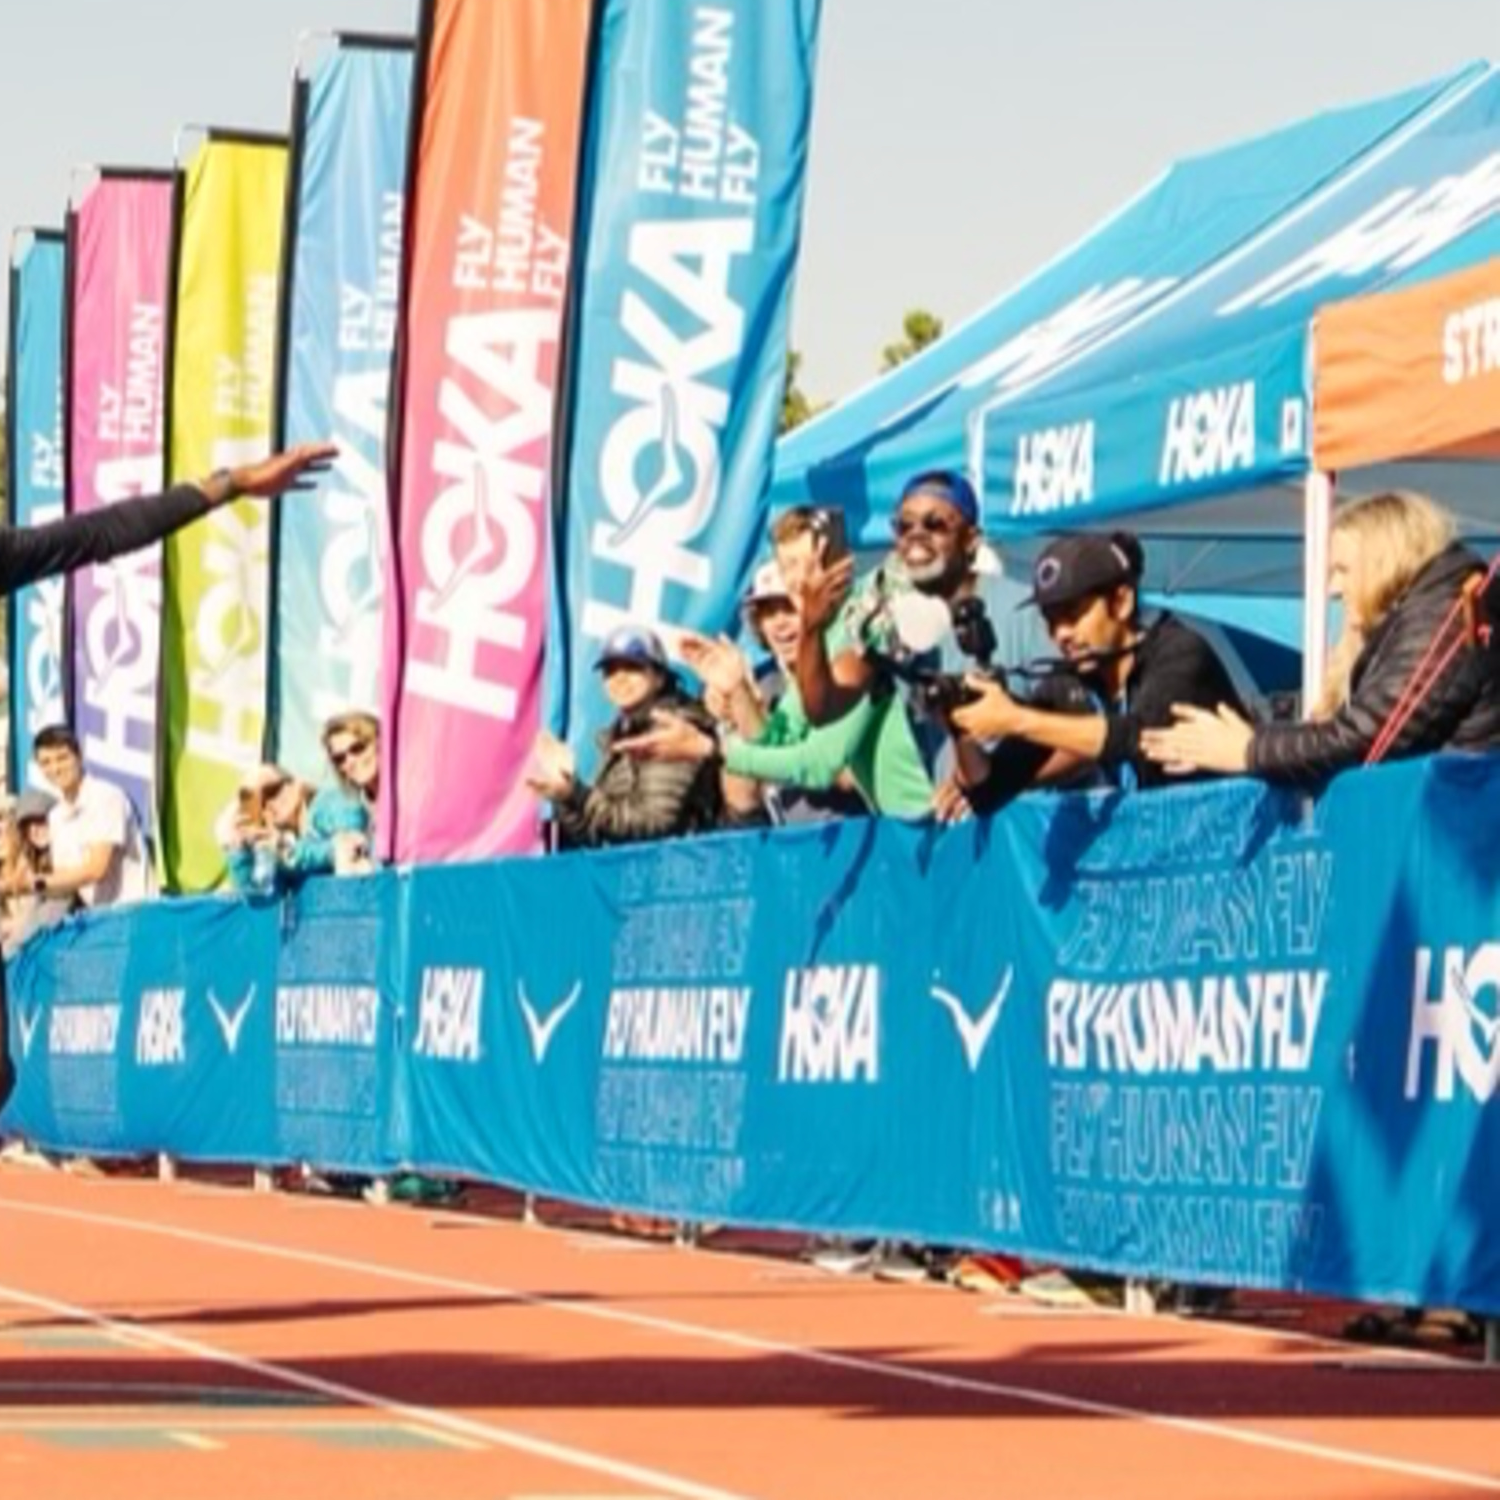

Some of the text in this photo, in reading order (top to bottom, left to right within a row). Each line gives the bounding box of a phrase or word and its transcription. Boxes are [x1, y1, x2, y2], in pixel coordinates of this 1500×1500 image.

[637, 110, 680, 193] FLY
[680, 6, 736, 199] HUMAN
[493, 116, 546, 294] HUMAN
[721, 121, 762, 205] FLY
[453, 214, 494, 290] FLY
[531, 223, 571, 299] FLY
[338, 281, 373, 351] FLY
[581, 217, 756, 650] HOKA
[1011, 421, 1094, 516] HOKA
[1161, 382, 1255, 484] HOKA
[404, 306, 560, 722] HOKA
[779, 965, 878, 1082] HOKA
